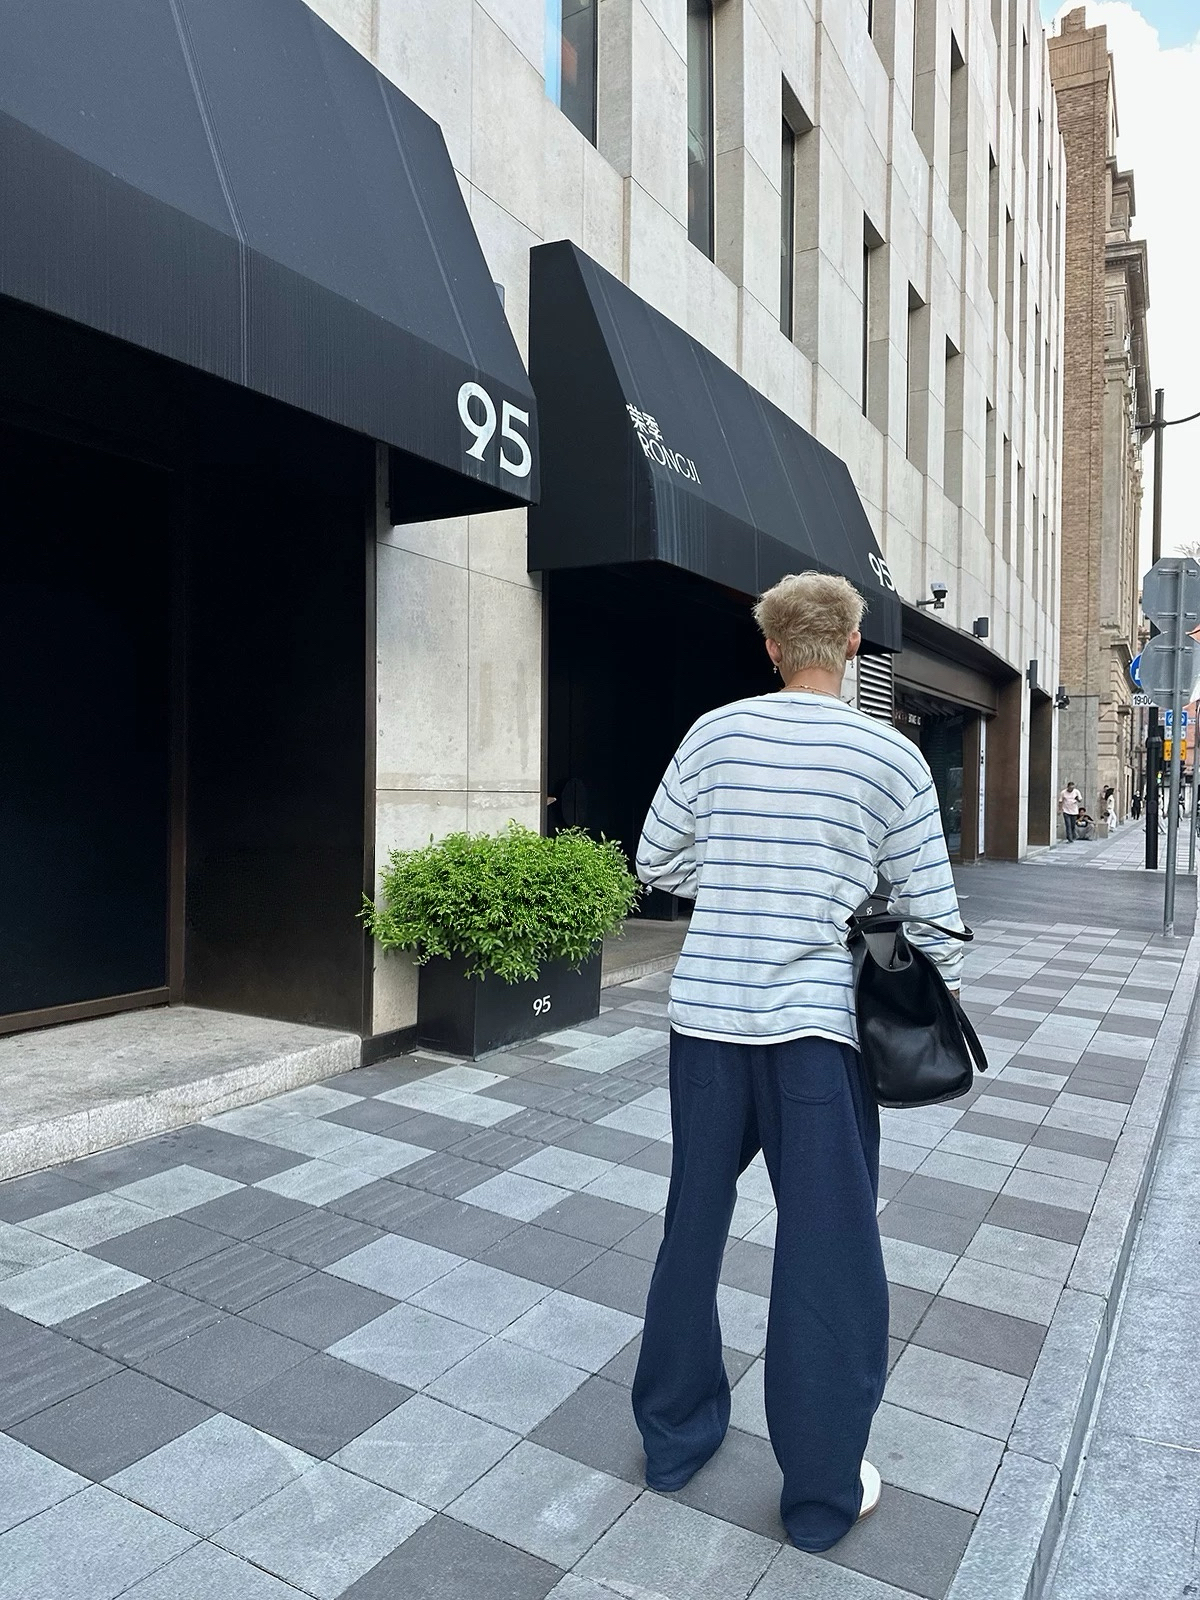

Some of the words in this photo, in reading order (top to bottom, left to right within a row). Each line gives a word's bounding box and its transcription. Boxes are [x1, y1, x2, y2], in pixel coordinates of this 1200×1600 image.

[457, 381, 532, 478] 95
[625, 402, 664, 442] 荣季
[637, 430, 702, 485] RONGJI
[868, 552, 895, 592] 95
[532, 994, 552, 1017] 95
